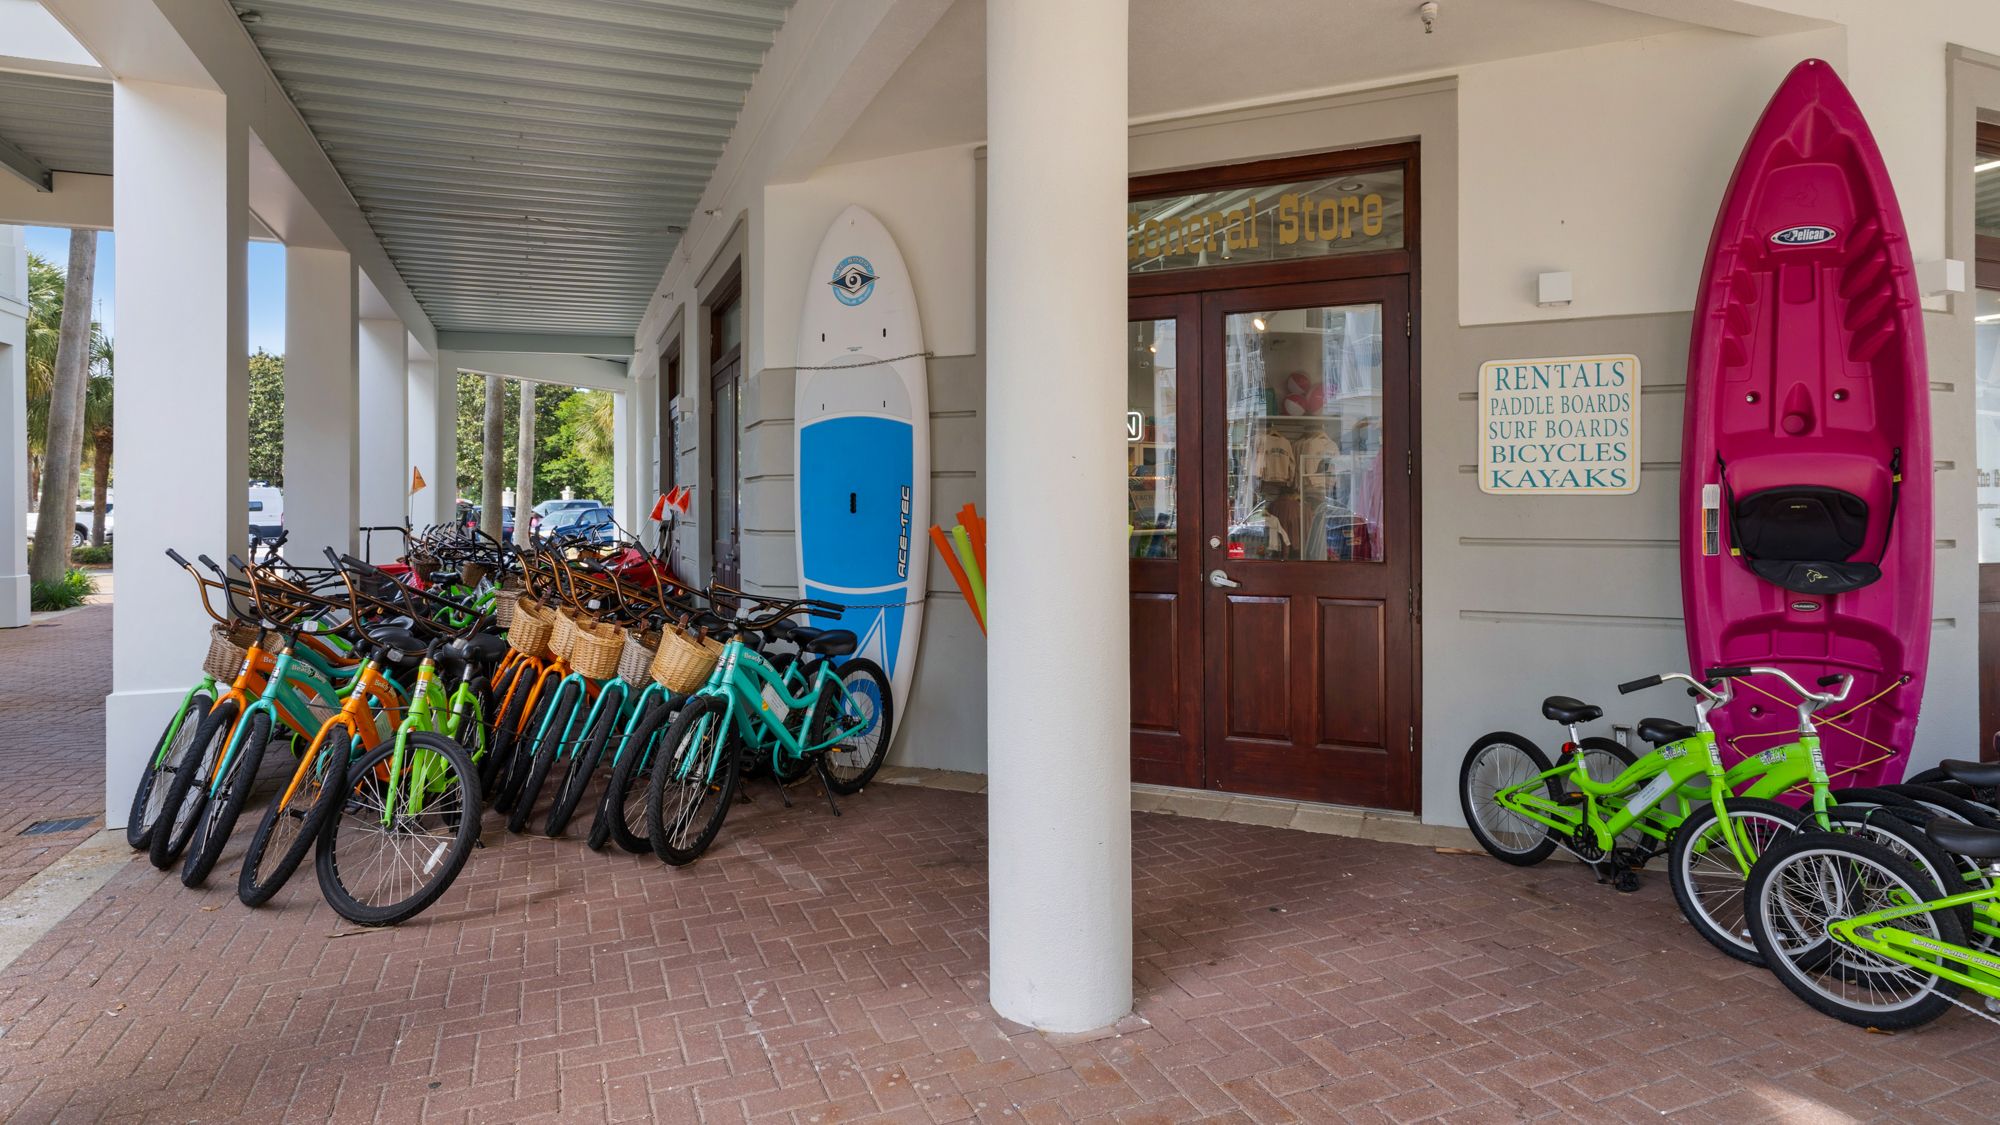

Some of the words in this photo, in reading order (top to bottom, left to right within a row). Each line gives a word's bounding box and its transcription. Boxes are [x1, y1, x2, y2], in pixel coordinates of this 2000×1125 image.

[1279, 193, 1383, 245] Store
[1791, 229, 1825, 241] Pelican
[1495, 361, 1625, 391] RENTALS
[1491, 396, 1555, 416] PADDLE
[1561, 393, 1630, 414] BOARDS
[1489, 420, 1537, 440] SURF
[1545, 418, 1630, 439] BOARDS
[1491, 442, 1628, 464] BICYCLES
[1491, 468, 1627, 488] KAYAKS
[897, 485, 910, 578] ACE-TEC
